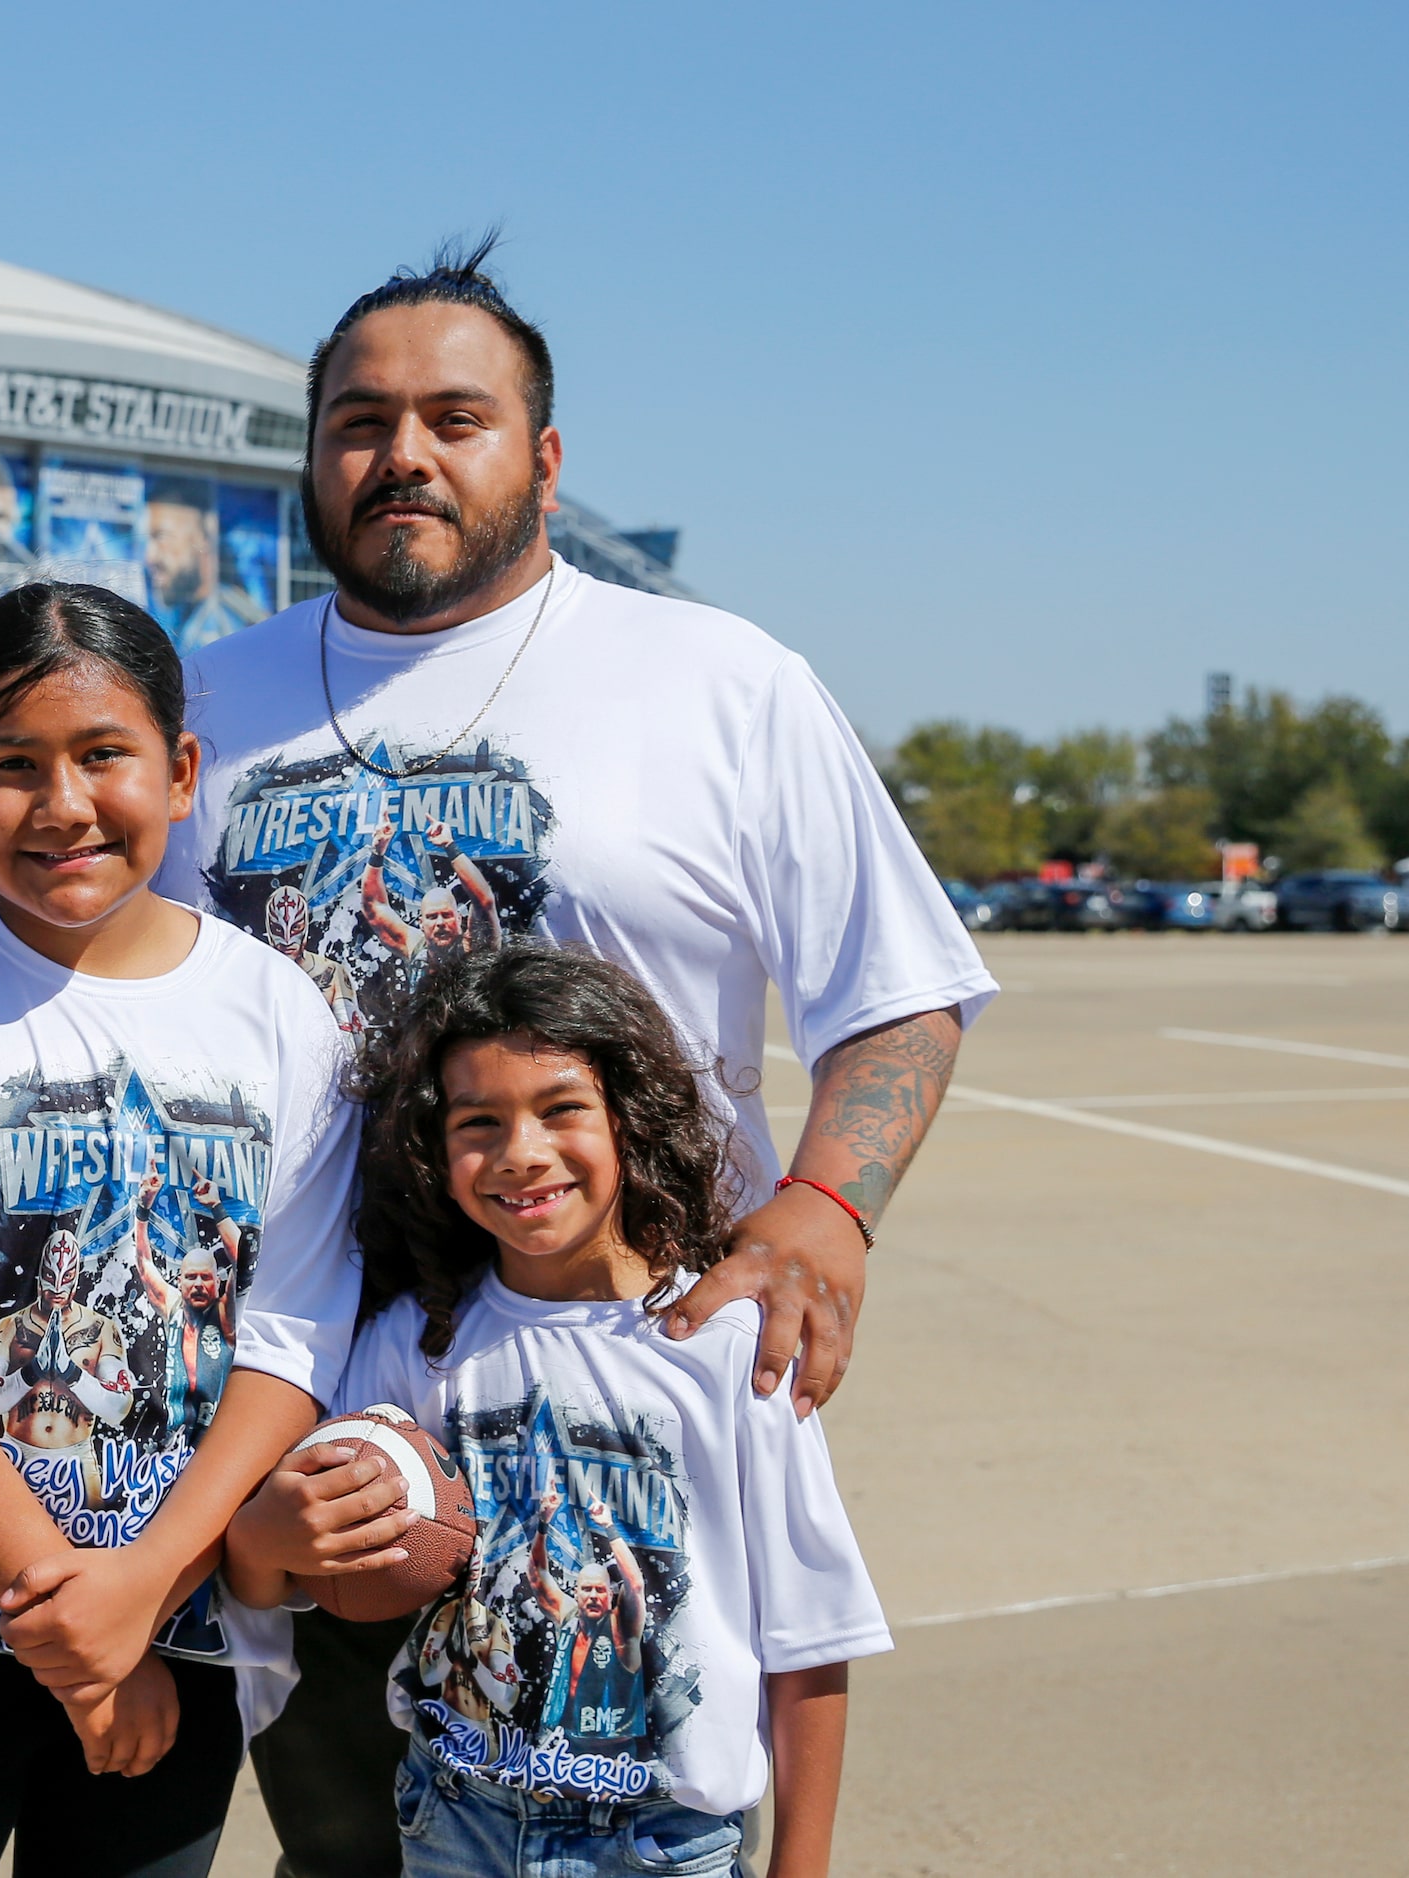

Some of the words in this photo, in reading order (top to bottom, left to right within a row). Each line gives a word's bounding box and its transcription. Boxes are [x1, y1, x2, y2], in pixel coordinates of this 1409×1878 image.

[87, 381, 252, 450] STADIUM
[232, 782, 530, 870] WRESTLEMANIA
[2, 1129, 271, 1209] WRESTLEMANI
[464, 1452, 681, 1549] RESTLEMANIA
[580, 1706, 626, 1732] BMF
